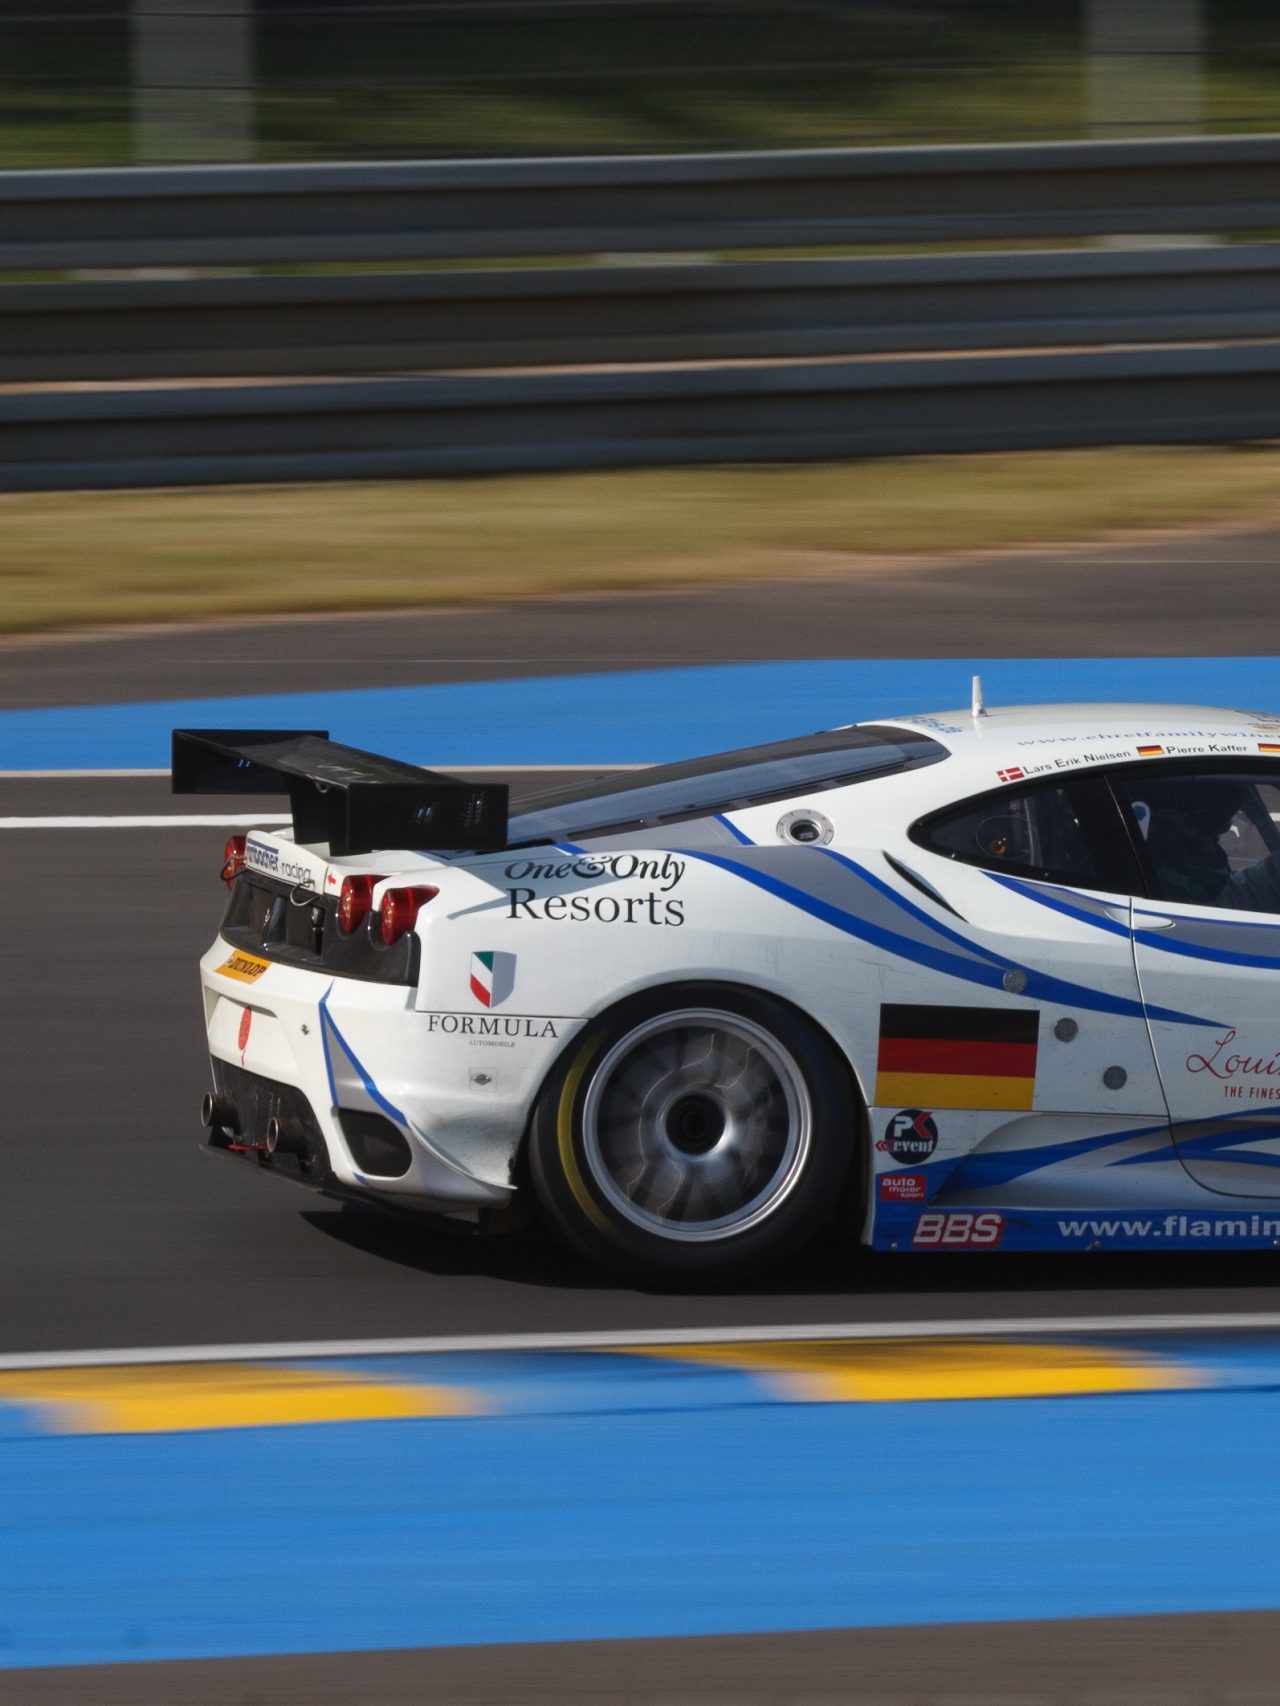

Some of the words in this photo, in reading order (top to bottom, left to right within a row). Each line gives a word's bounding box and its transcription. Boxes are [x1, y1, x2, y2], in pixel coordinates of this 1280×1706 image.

[1166, 746, 1205, 755] Pierre
[1208, 744, 1248, 753] Kaffer
[1023, 766, 1052, 775] Lars
[1055, 758, 1081, 769] Erik
[1083, 750, 1132, 763] Nielsen
[506, 887, 685, 927] Resorts
[228, 957, 267, 976] DUNLOP
[428, 1014, 559, 1038] FORMULA
[469, 1040, 516, 1048] AUTOMOBILE
[1223, 1085, 1243, 1098] THE
[892, 1140, 934, 1153] event
[882, 1177, 917, 1187] auto
[912, 1213, 1002, 1243] BBS
